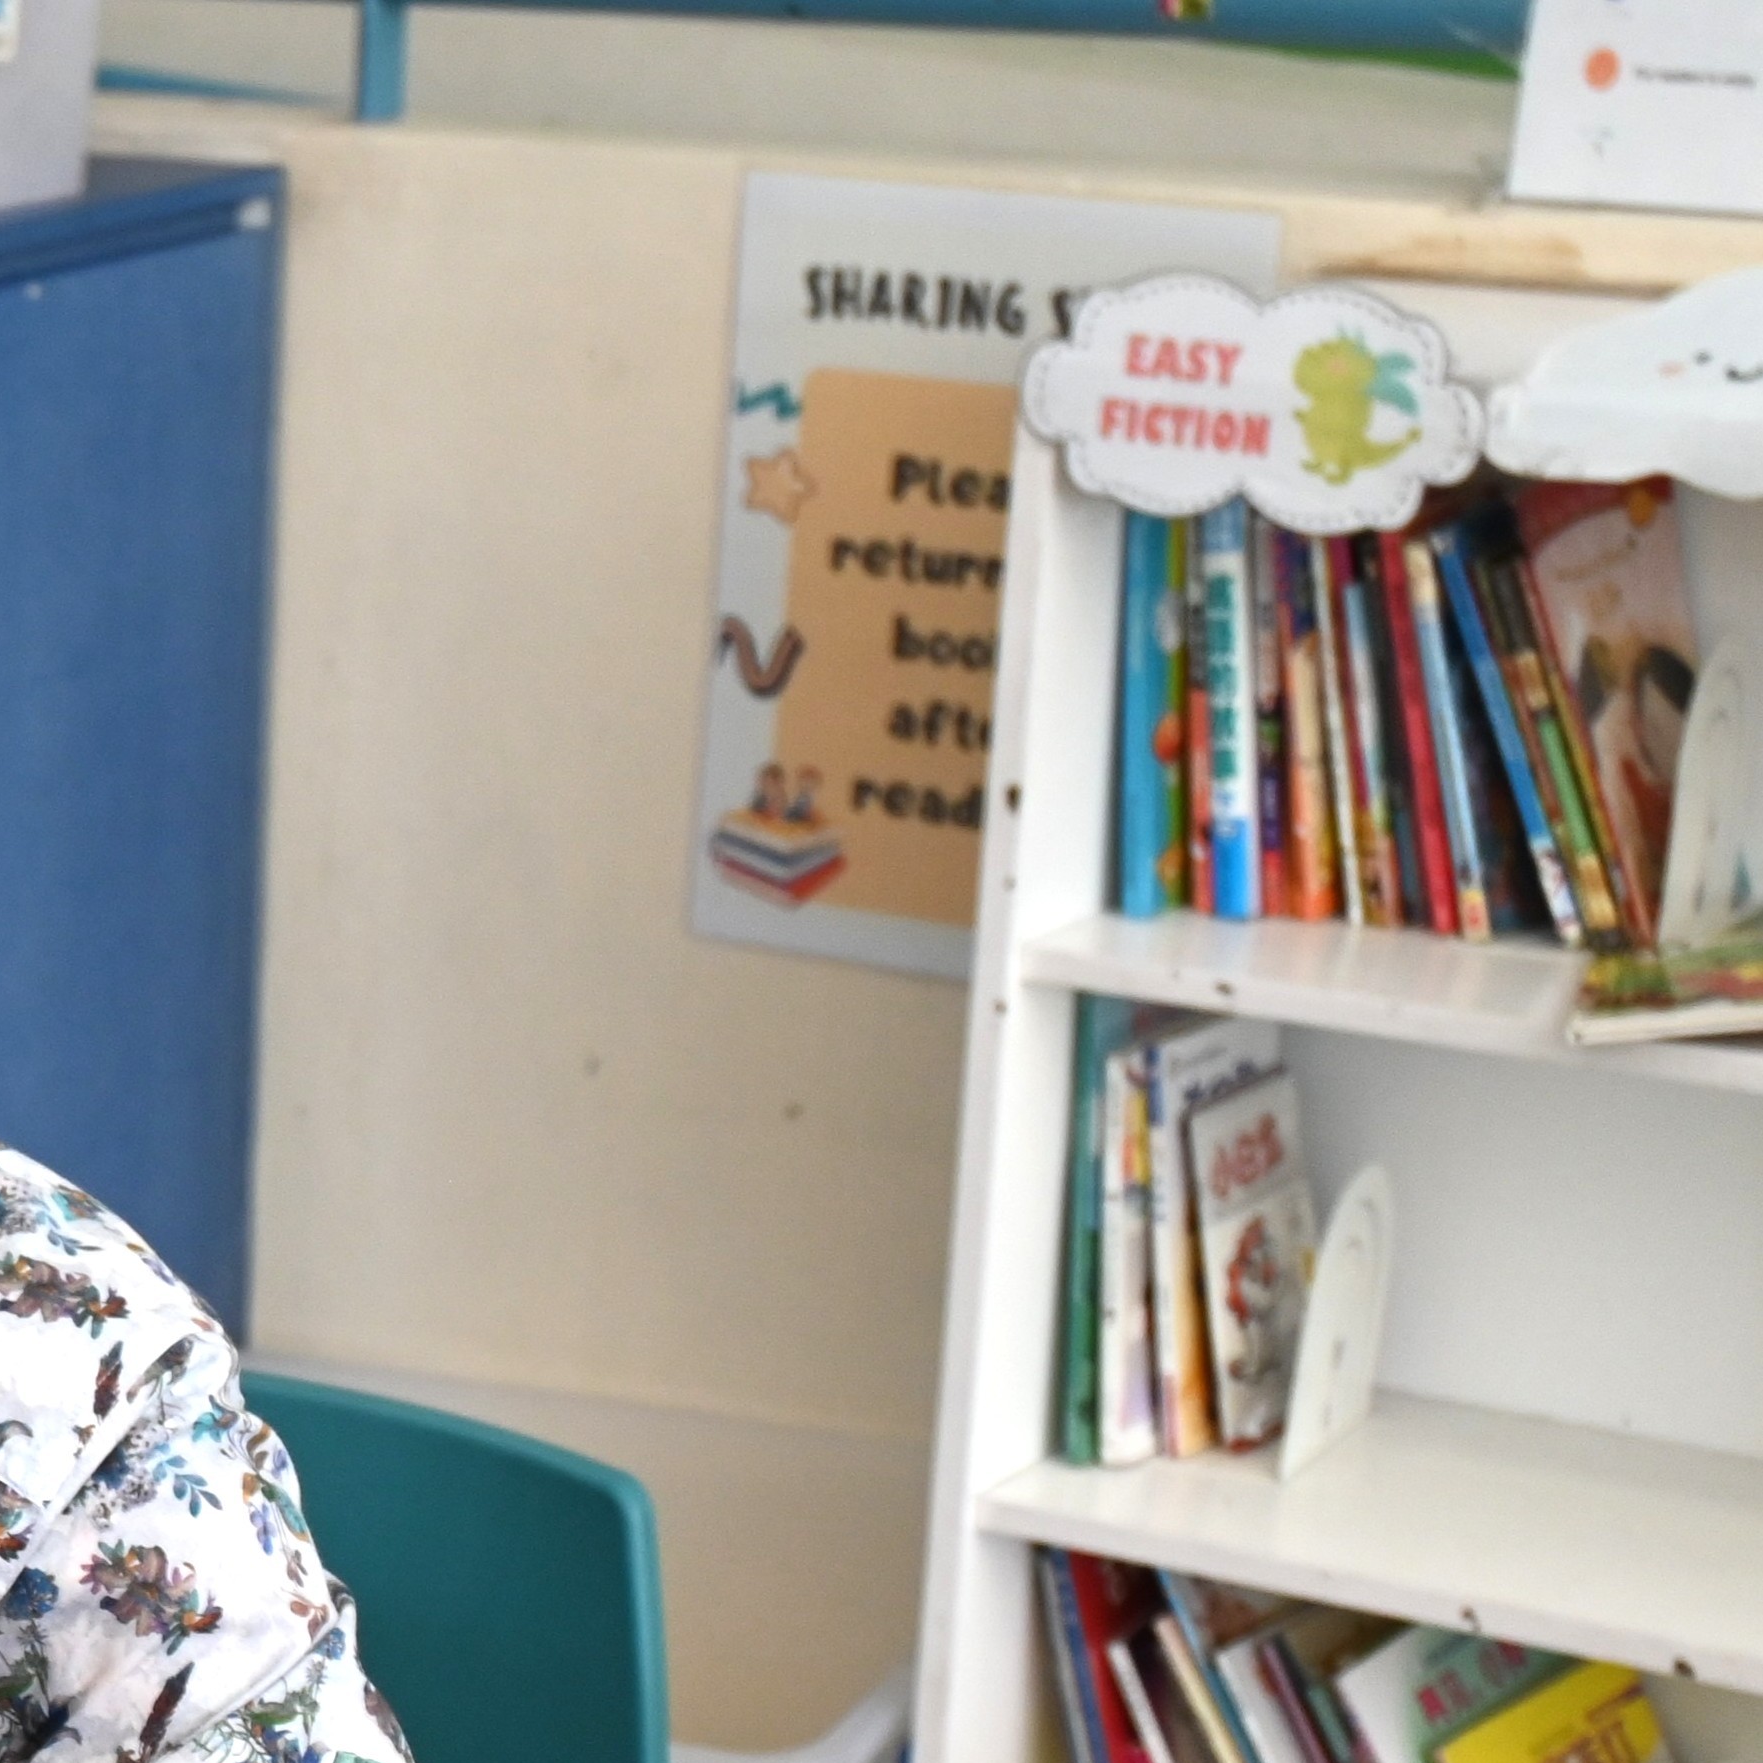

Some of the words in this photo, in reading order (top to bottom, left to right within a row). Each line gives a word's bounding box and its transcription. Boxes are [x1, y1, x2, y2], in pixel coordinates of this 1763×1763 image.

[805, 266, 1025, 337] SHARING
[1125, 334, 1242, 386] EASY
[1101, 398, 1270, 456] FICTION
[891, 452, 1010, 512] Plea
[891, 613, 997, 672] boo
[852, 777, 984, 830] read
